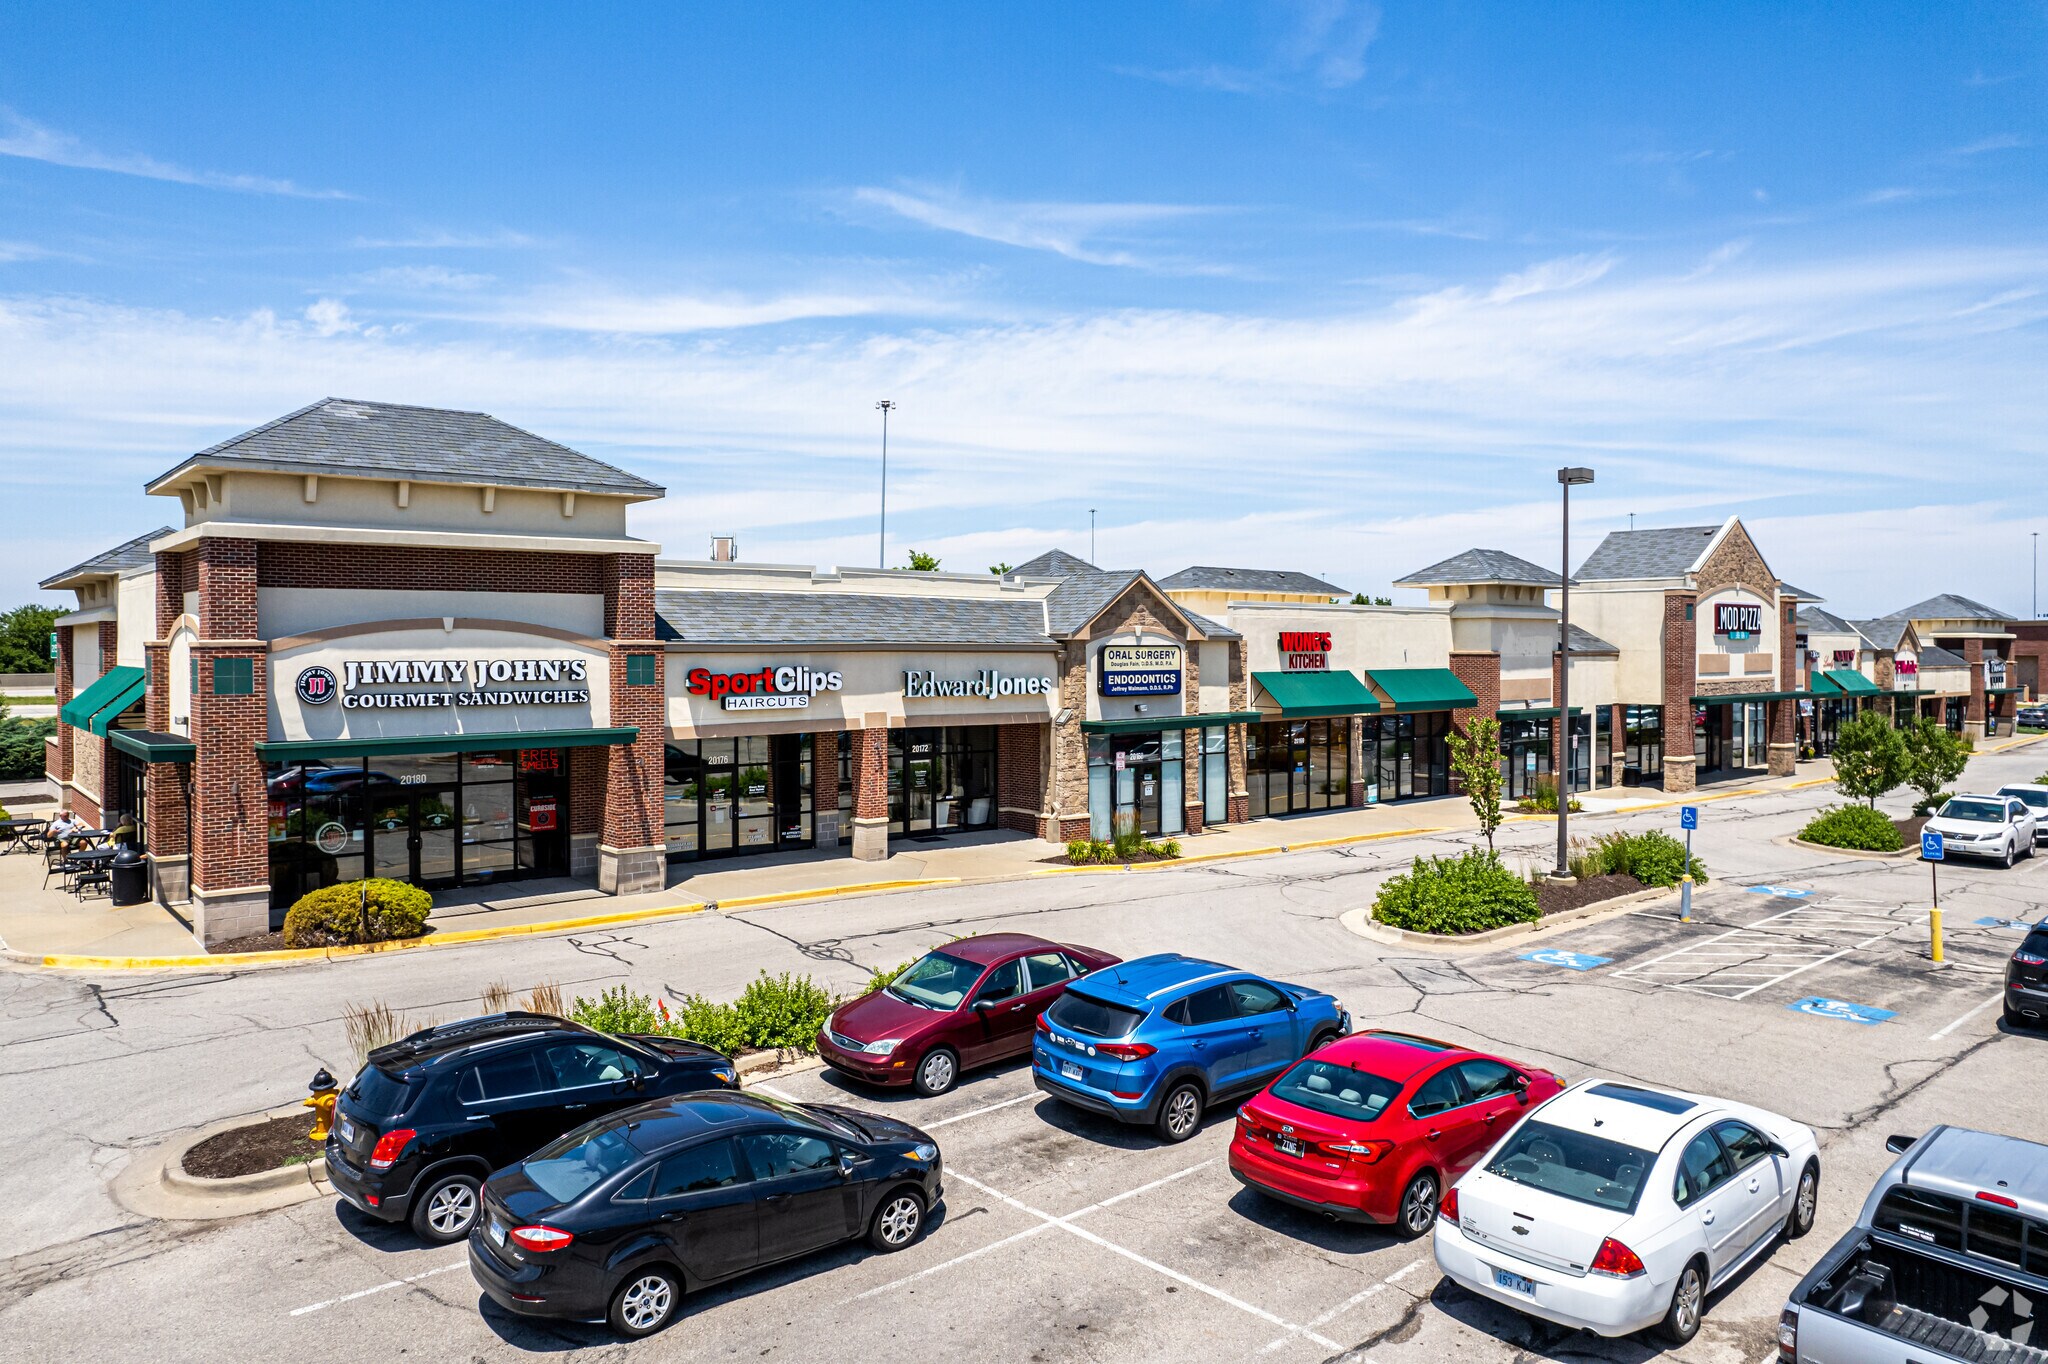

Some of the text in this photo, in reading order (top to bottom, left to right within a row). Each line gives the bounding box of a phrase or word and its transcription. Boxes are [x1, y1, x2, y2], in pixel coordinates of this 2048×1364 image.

[1740, 607, 1761, 630] PIZZA
[1279, 631, 1332, 651] WONG'S
[1108, 650, 1176, 660] ORAL SURGERY
[1288, 653, 1325, 669] KITCHEN
[343, 659, 588, 691] JIMMY JOHN'S
[1108, 673, 1177, 685] ENDODONTICS
[308, 677, 326, 695] JJ
[342, 692, 453, 709] GOURMET
[457, 689, 589, 707] SANDWICHES
[726, 696, 808, 709] HAIRCUTS
[520, 748, 559, 761] FREE
[911, 744, 929, 753] 20172
[520, 759, 559, 771] SMELLS
[708, 755, 729, 765] 20176
[400, 773, 427, 785] 20180
[1498, 1273, 1533, 1295] 153 KJW
